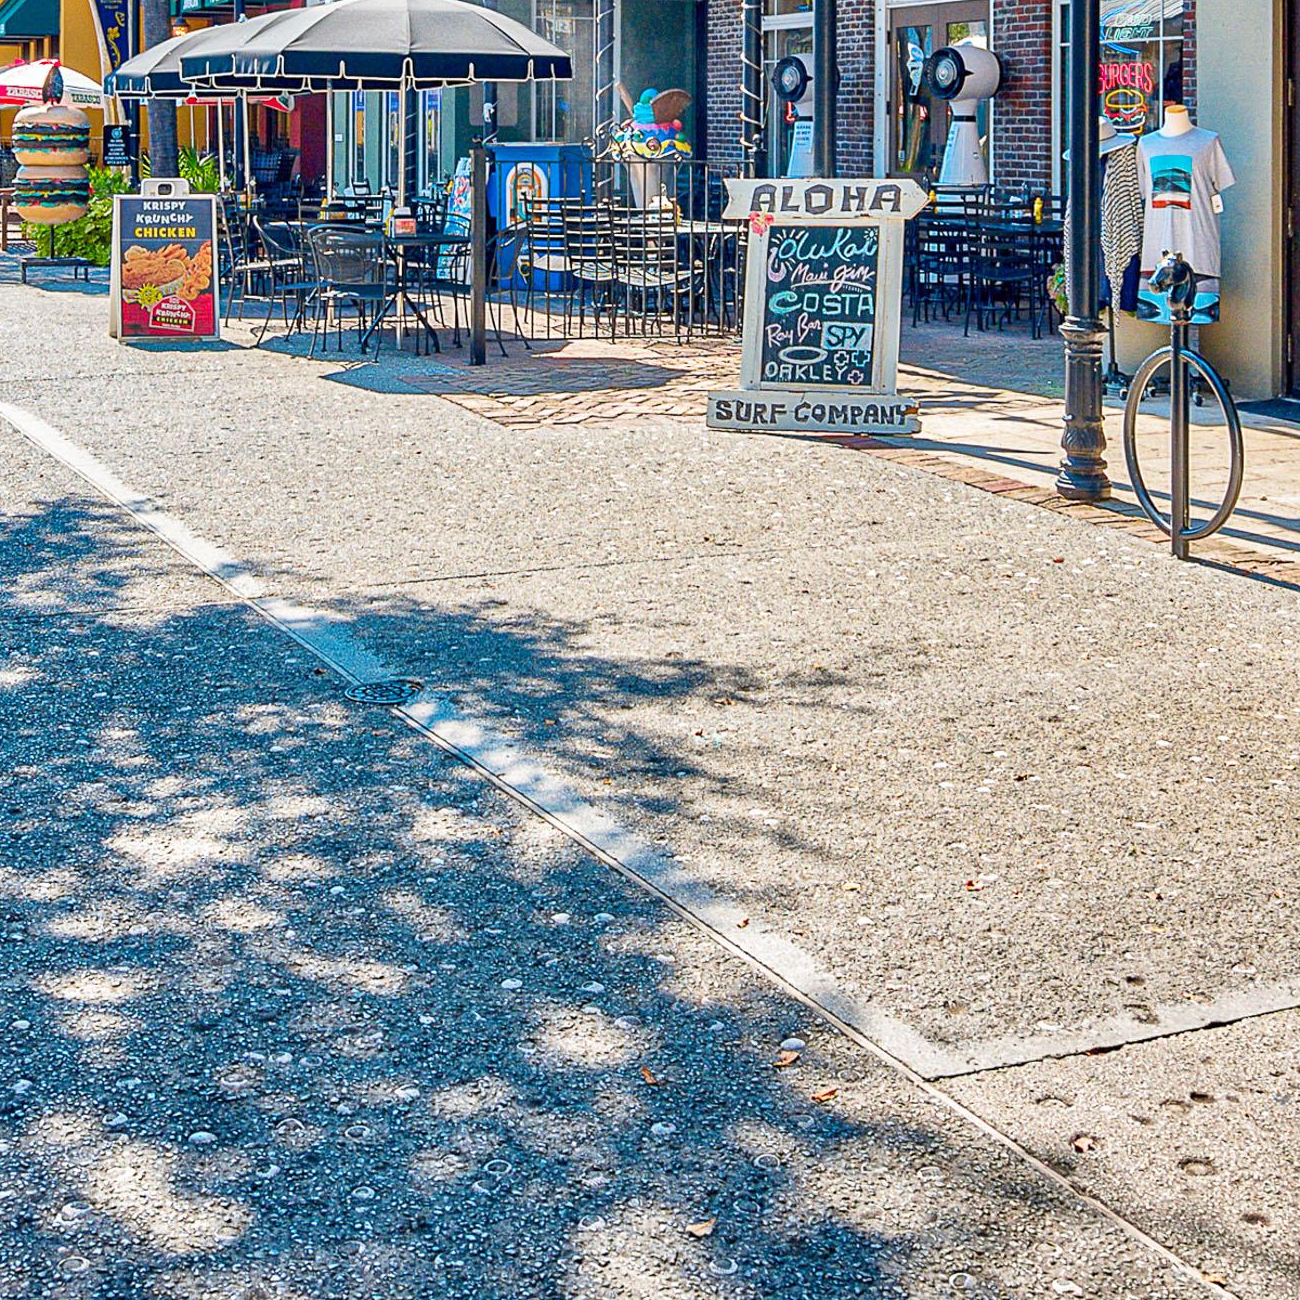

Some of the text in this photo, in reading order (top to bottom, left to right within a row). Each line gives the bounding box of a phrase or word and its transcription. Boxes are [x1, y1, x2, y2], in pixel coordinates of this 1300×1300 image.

[1098, 62, 1152, 93] BURGERS
[143, 201, 186, 211] KRISPY
[750, 183, 901, 215] ALOHA
[136, 213, 193, 224] KRUNCHY
[134, 227, 197, 238] CHICKEN
[161, 303, 187, 311] KRISPY
[768, 290, 875, 316] COSTA
[156, 316, 189, 325] CHICKEN
[826, 325, 866, 348] SPY
[764, 361, 849, 382] OAKLEY
[716, 401, 913, 427] SURF COMPANY
